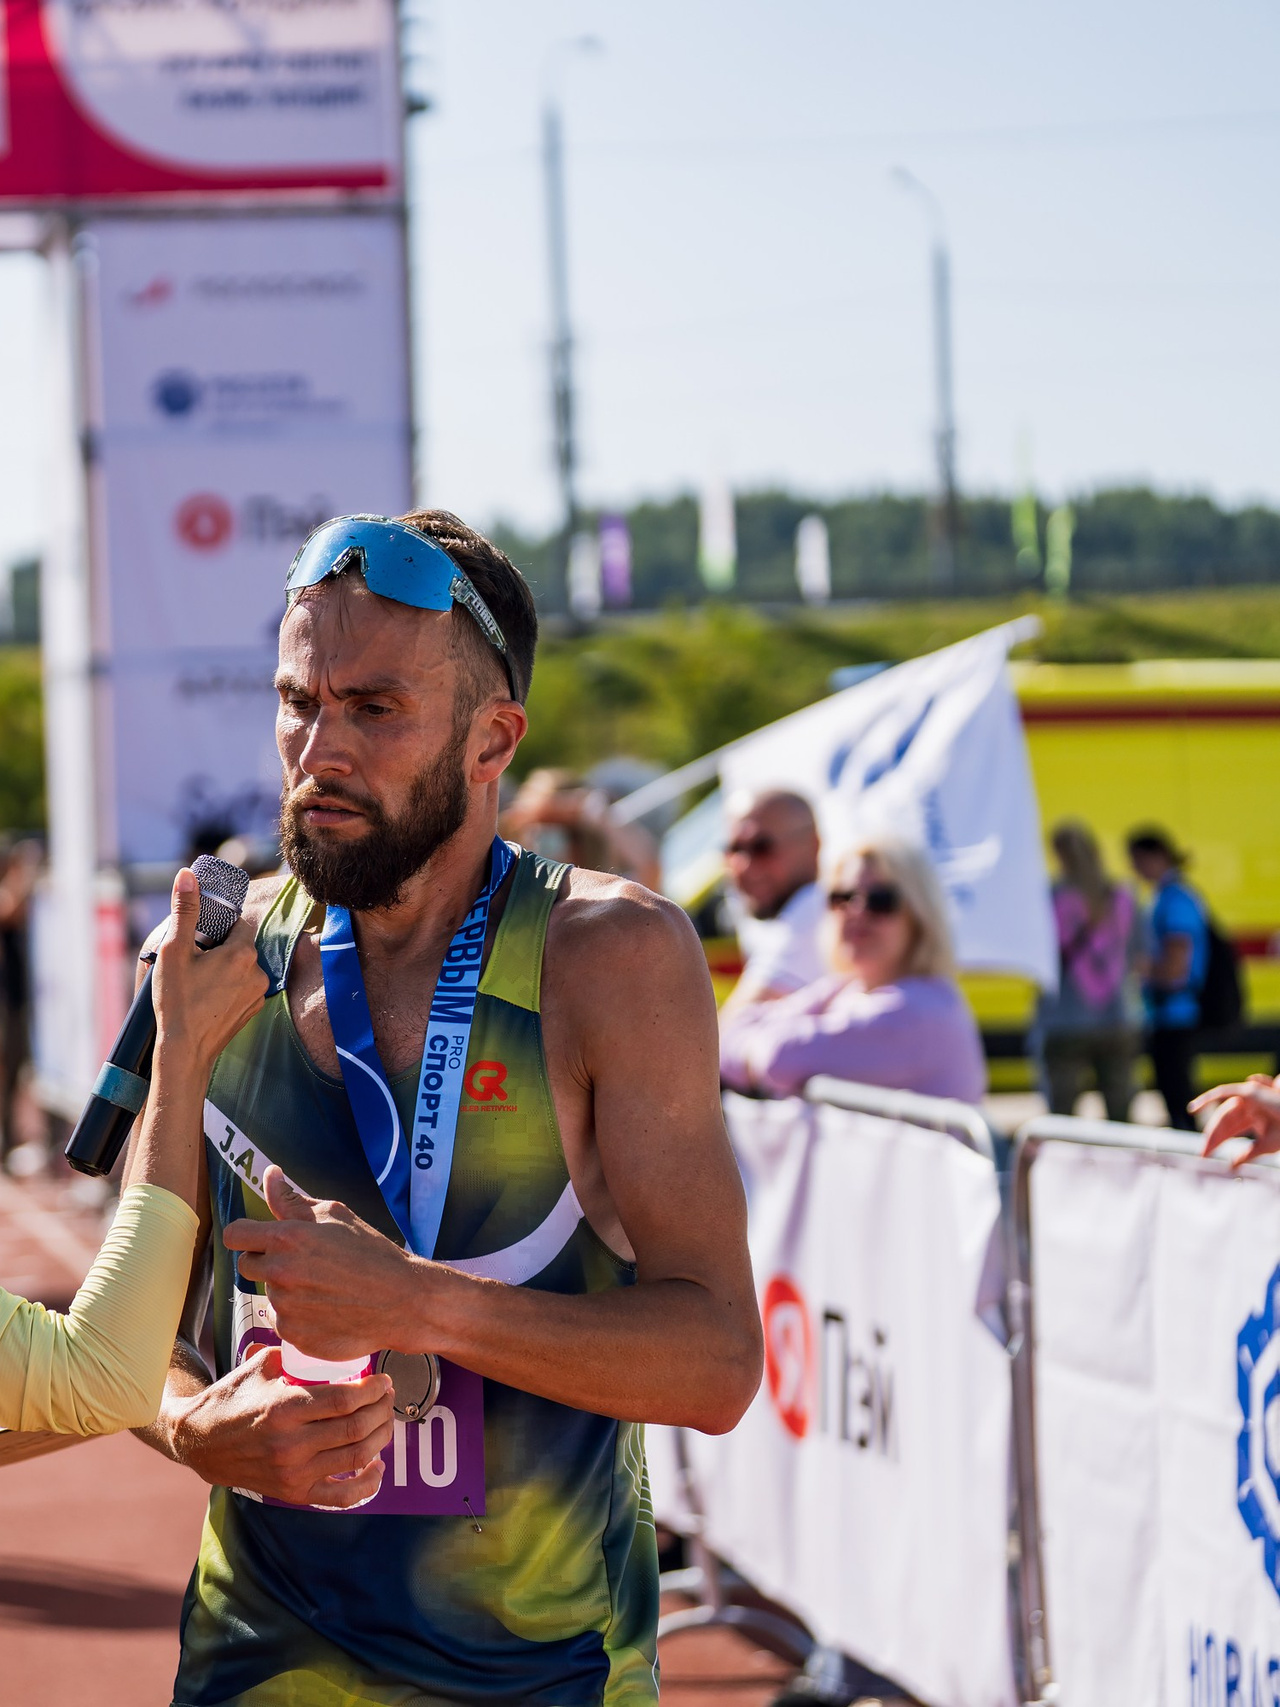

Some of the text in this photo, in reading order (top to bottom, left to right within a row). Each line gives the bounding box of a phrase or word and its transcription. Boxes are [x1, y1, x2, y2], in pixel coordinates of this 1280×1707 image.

[429, 886, 491, 1024] ЕРВЫМ
[414, 1034, 449, 1170] СПОРТ 40
[448, 1035, 465, 1070] PRO
[820, 1308, 900, 1464] Пэй
